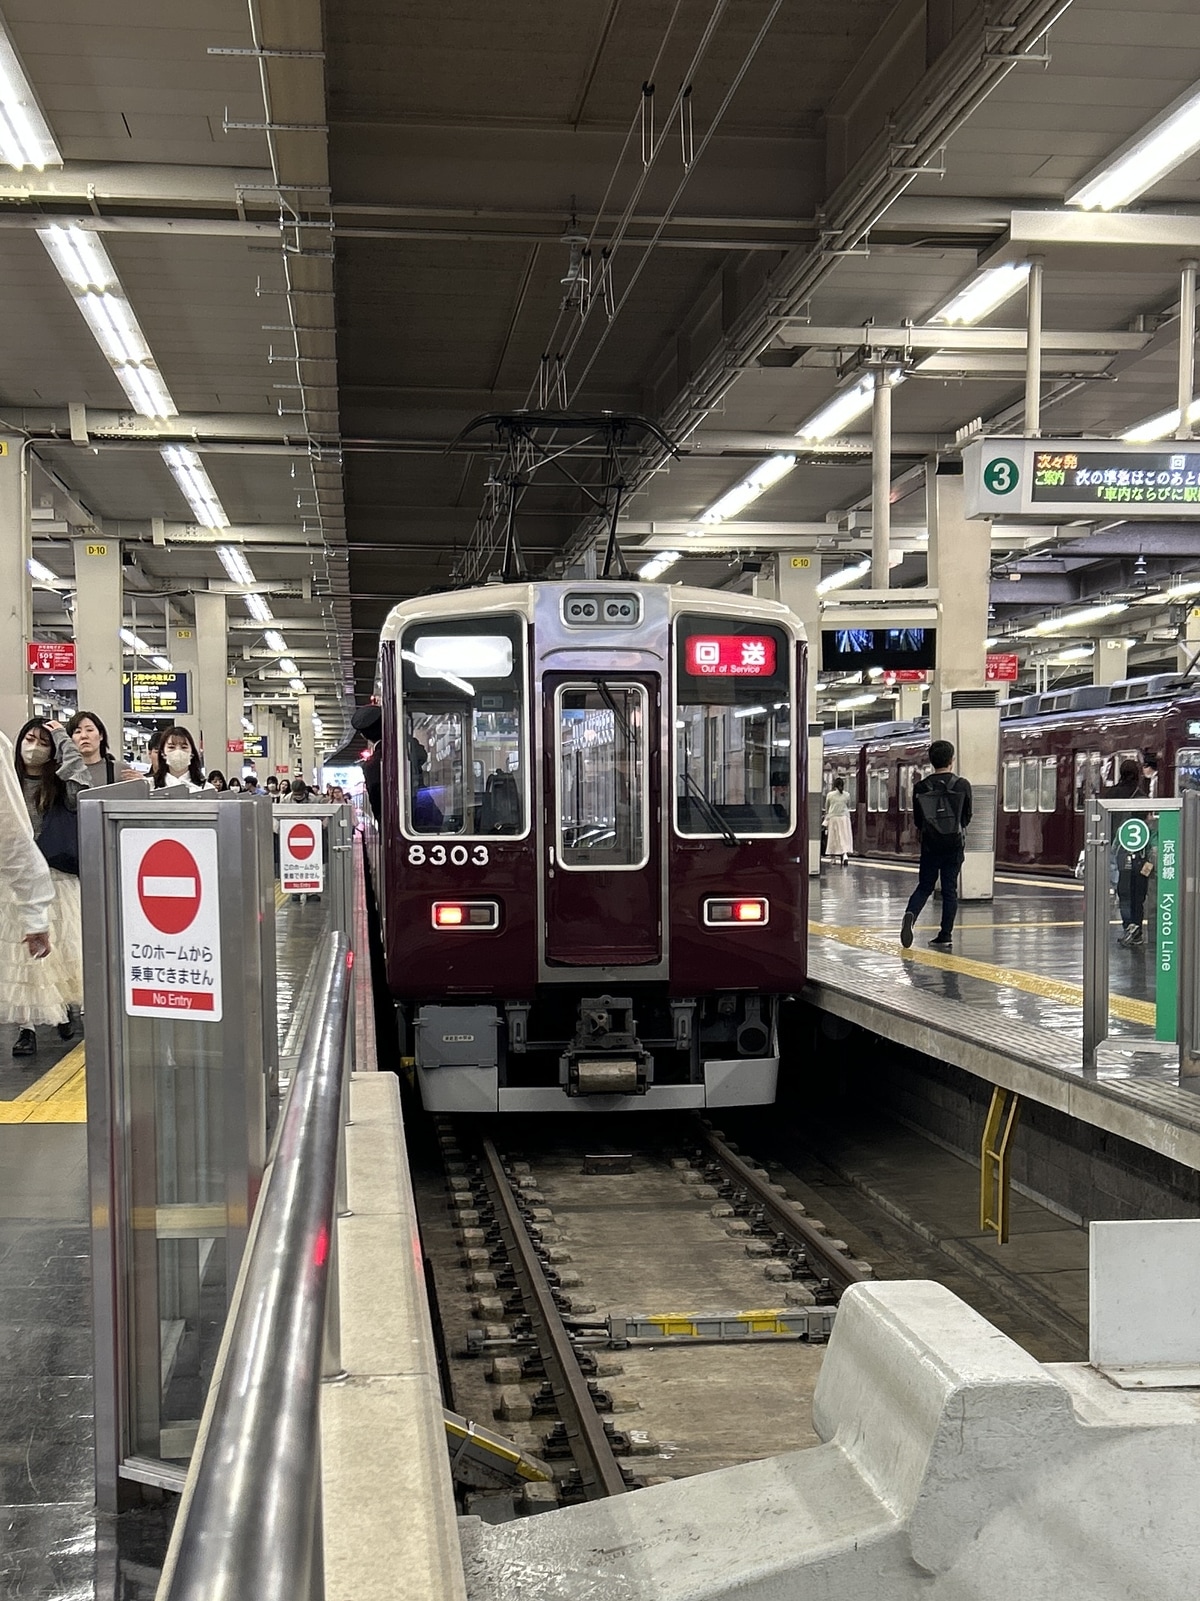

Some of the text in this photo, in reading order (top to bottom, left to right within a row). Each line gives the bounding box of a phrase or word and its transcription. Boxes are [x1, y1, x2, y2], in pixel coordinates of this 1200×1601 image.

[1037, 454, 1185, 470] 次々発 回
[992, 462, 1011, 491] 3
[1075, 469, 1200, 486] 次の準急はこのあと
[695, 641, 766, 665] 回送
[701, 664, 760, 673] Out of Service
[1126, 824, 1142, 846] 3
[408, 844, 489, 866] 8303
[1162, 839, 1175, 880] 京都線
[1160, 893, 1175, 972] Kyoto Line
[131, 943, 213, 962] このホームから
[131, 965, 214, 986] 乗車できません
[152, 992, 193, 1009] No Entry
